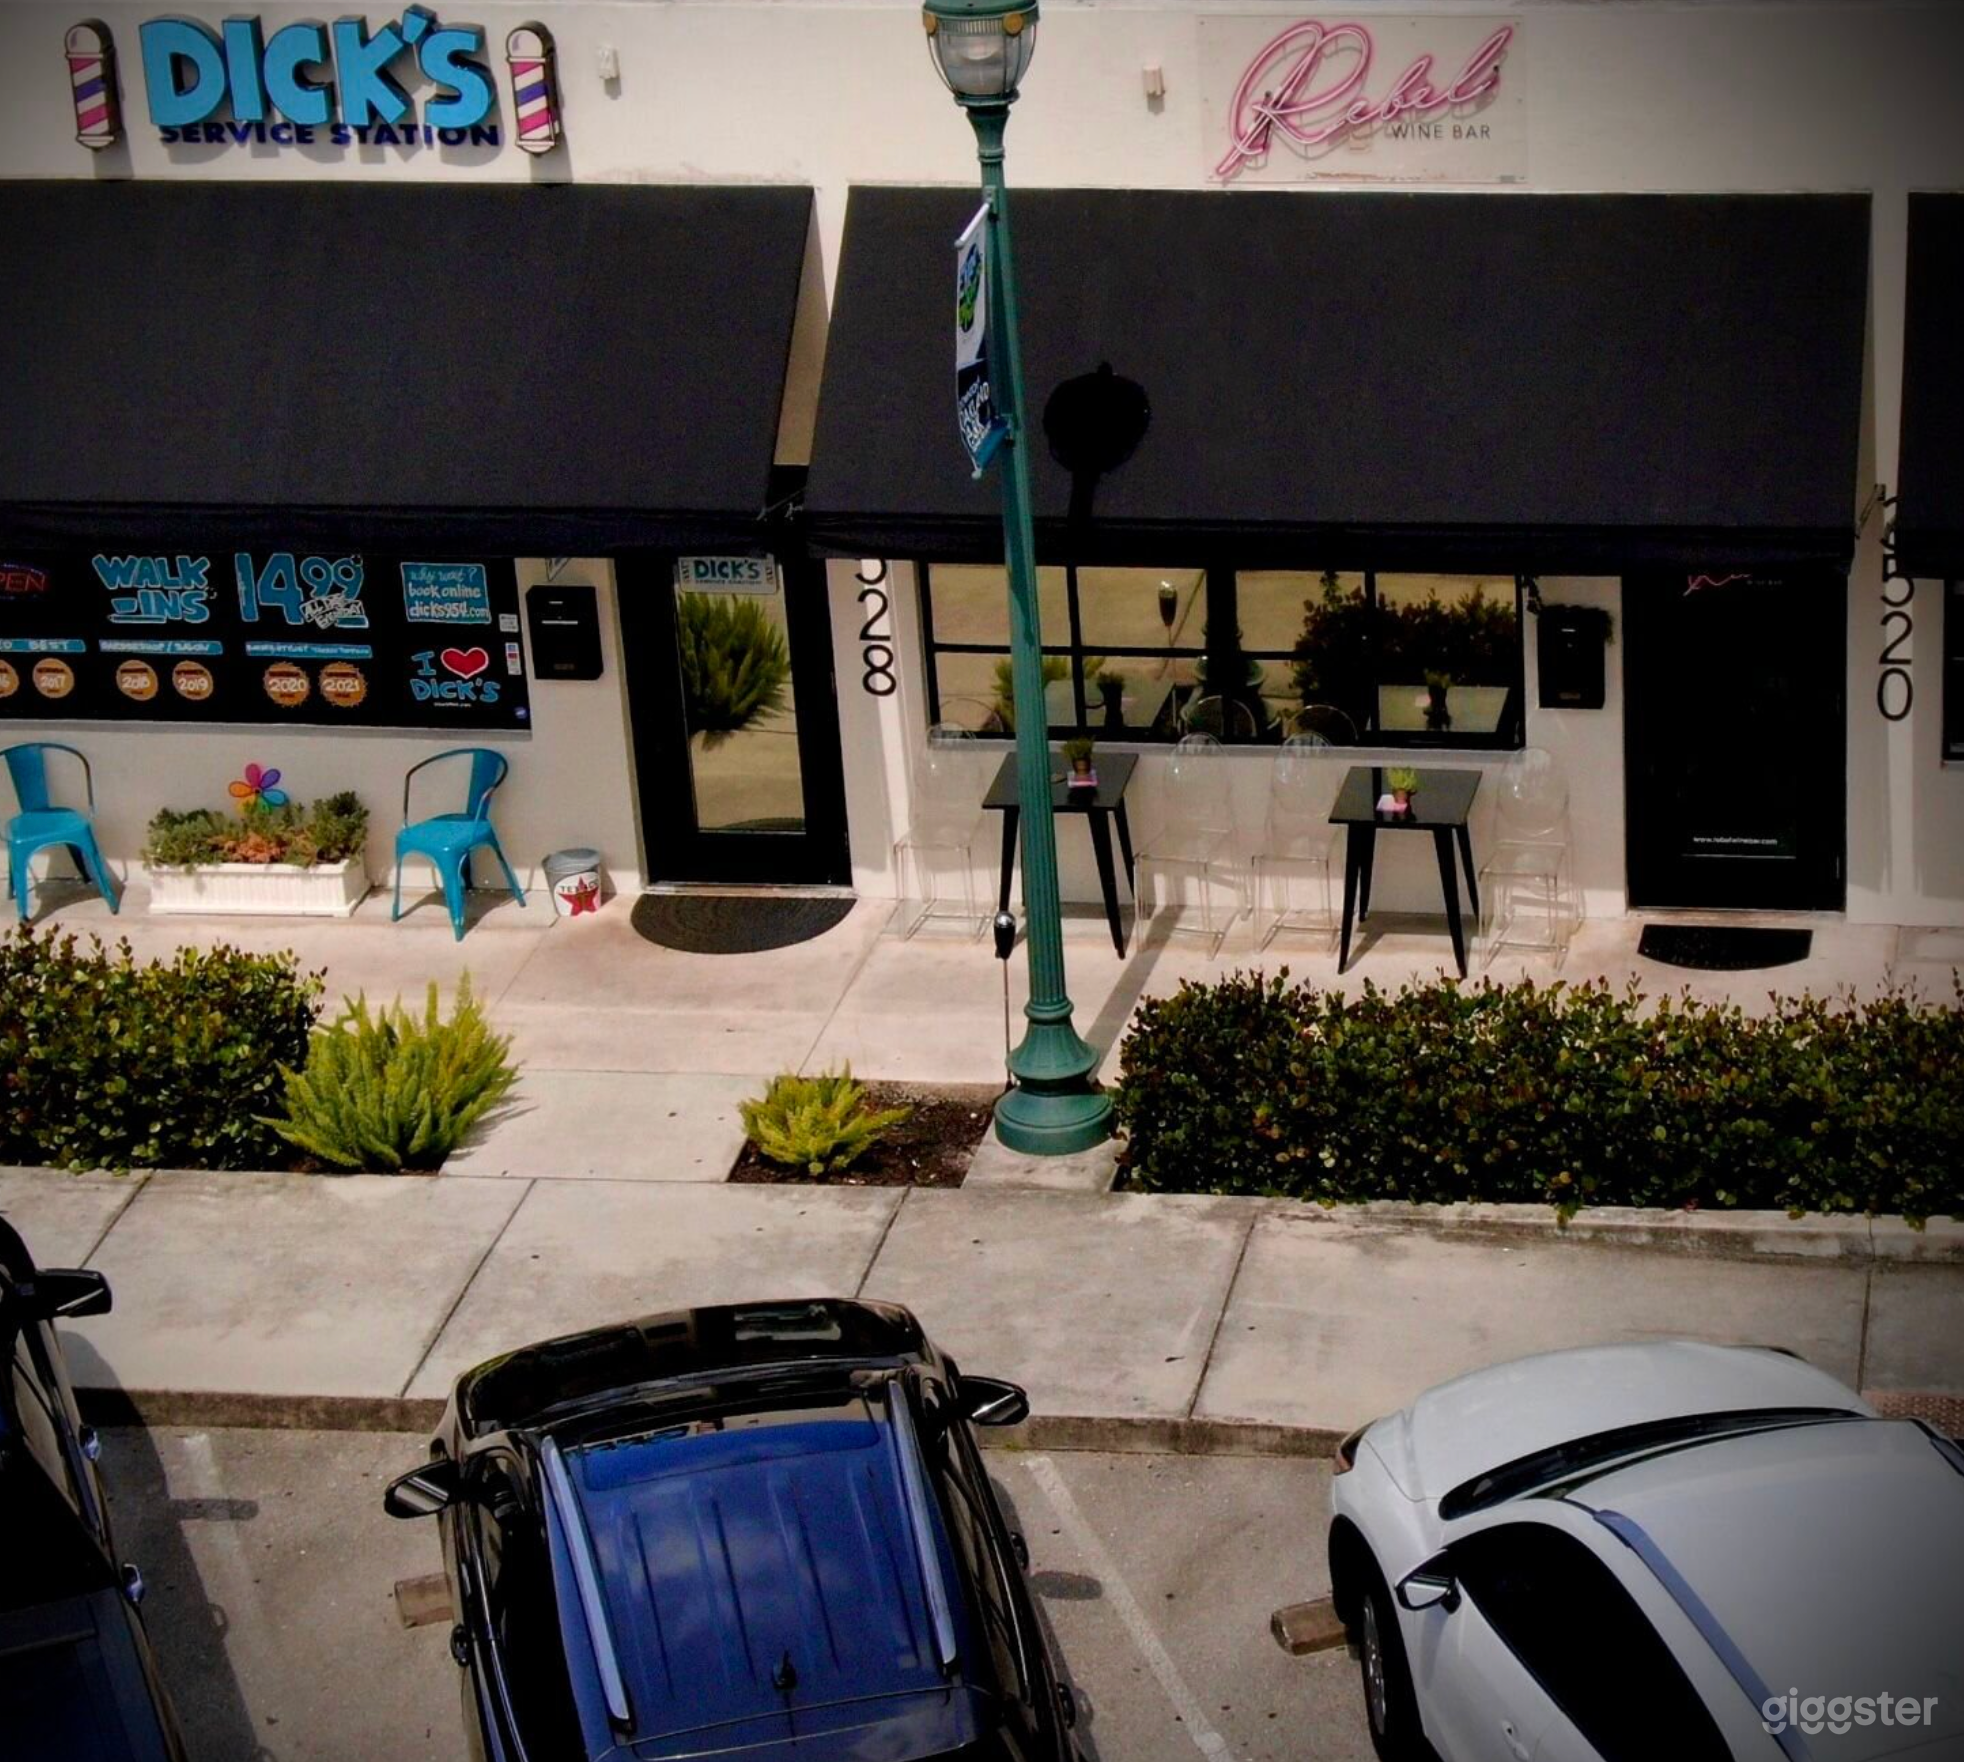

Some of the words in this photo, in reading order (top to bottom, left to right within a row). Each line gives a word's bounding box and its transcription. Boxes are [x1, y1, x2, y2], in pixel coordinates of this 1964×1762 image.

[139, 5, 497, 129] DICK'S
[159, 121, 315, 145] SERVICE
[331, 121, 500, 148] STATION
[1391, 124, 1443, 139] WINE
[1453, 125, 1491, 140] BAR
[92, 554, 211, 590] WALK
[694, 559, 761, 580] DICK'S
[0, 572, 46, 592] EN
[408, 582, 440, 599] book
[441, 583, 482, 599] online
[411, 650, 438, 676] I
[269, 678, 307, 692] 2020
[324, 678, 361, 692] 2021
